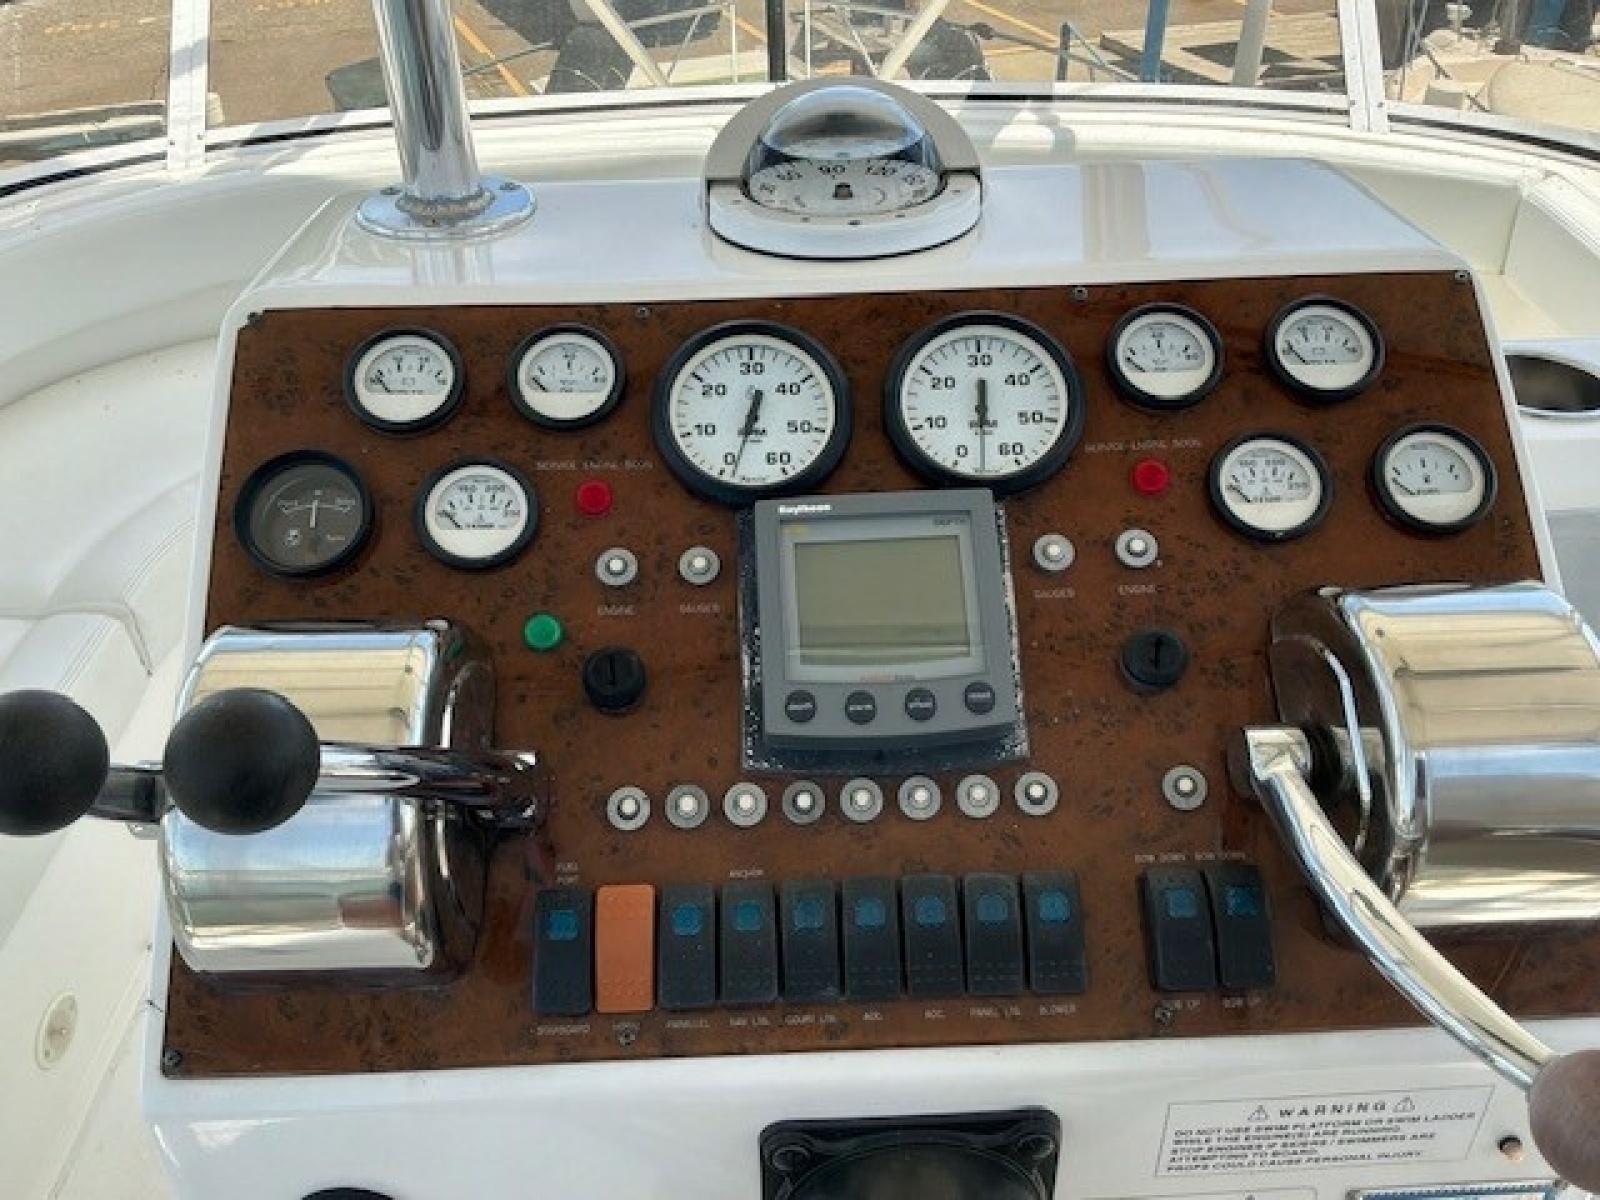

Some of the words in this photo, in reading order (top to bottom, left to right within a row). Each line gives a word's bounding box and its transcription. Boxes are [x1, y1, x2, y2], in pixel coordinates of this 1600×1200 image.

[966, 353, 993, 367] 30
[738, 361, 766, 376] 30
[930, 375, 956, 390] 20
[1004, 372, 1031, 387] 40
[701, 382, 728, 397] 20
[774, 382, 801, 396] 40
[924, 415, 947, 430] 10
[1017, 411, 1043, 425] 50
[694, 423, 716, 437] 10
[786, 420, 811, 434] 50
[955, 443, 969, 459] 0
[999, 442, 1025, 456] 60
[723, 451, 736, 467] 0
[765, 451, 791, 466] 60
[1278, 1102, 1386, 1118] WARNING
